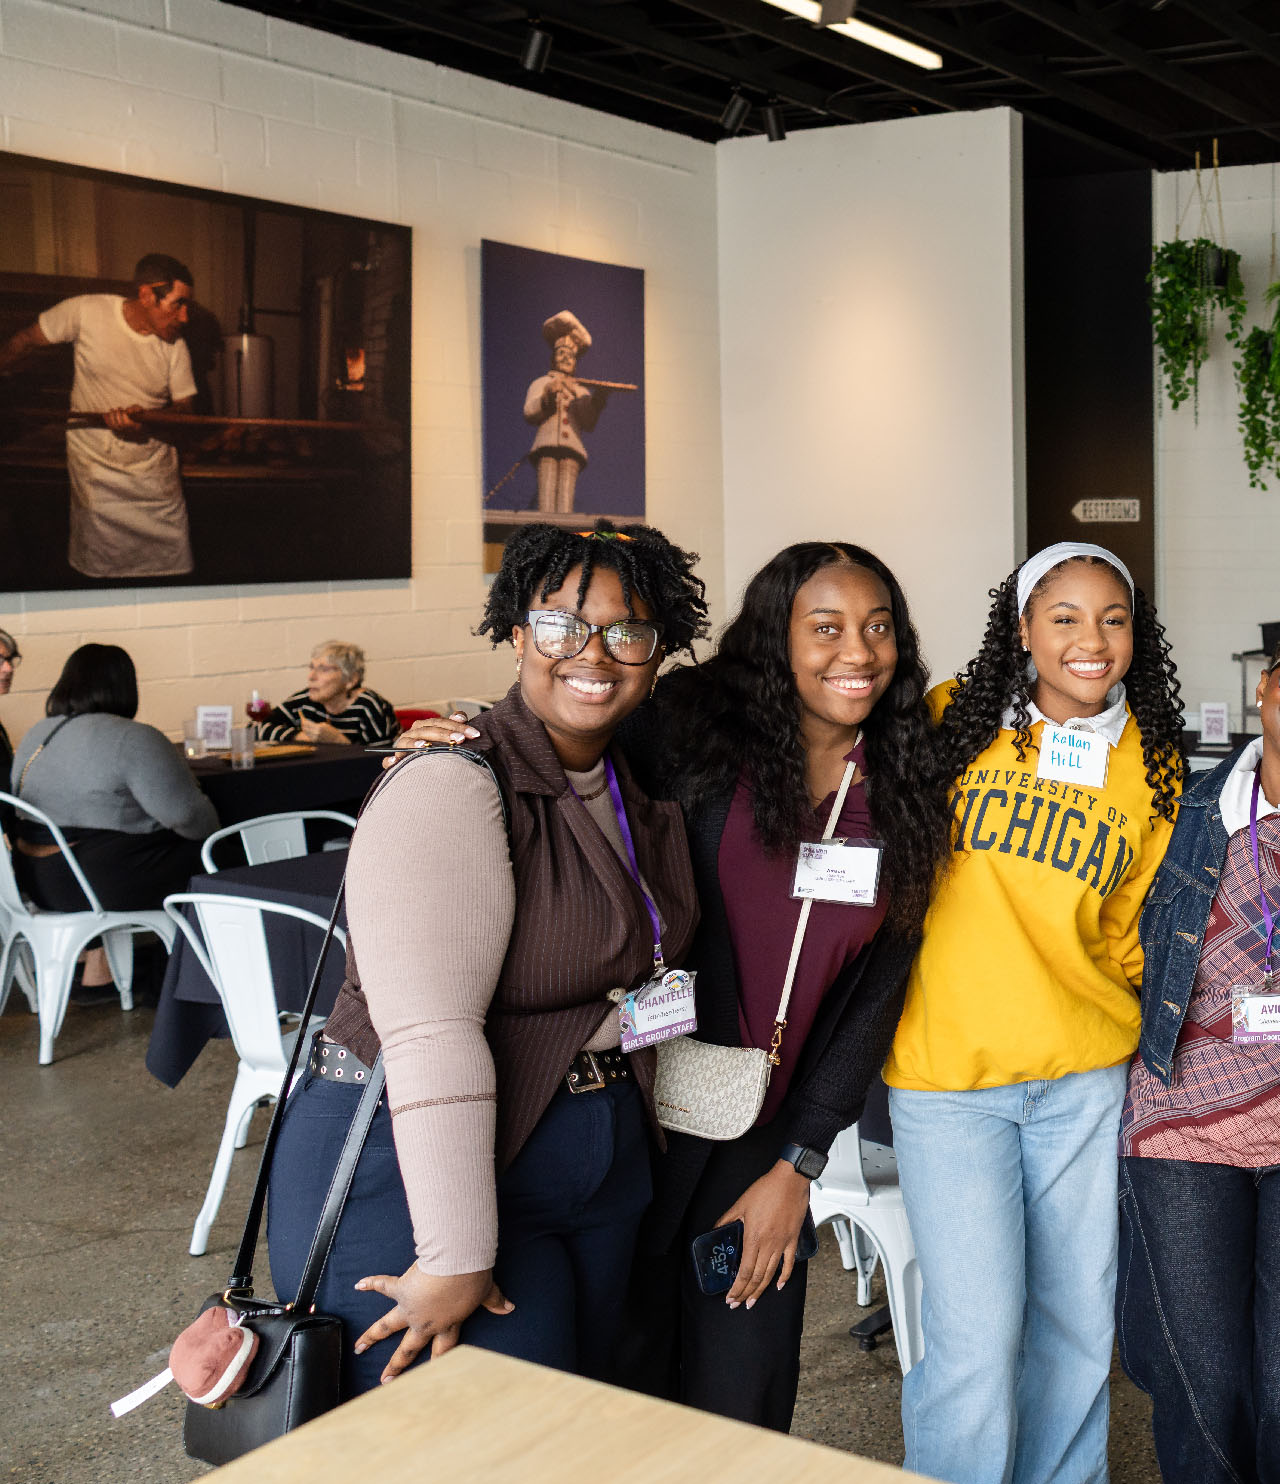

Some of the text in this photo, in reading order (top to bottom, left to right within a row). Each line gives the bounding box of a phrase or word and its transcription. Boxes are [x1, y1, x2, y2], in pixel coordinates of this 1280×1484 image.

[1082, 501, 1137, 519] RESTROOMS
[960, 769, 1128, 829] UNIVERSITY OF
[637, 986, 693, 1011] CHANTELLE
[622, 1021, 694, 1050] GIRLS GROUP STAFF
[1233, 1035, 1260, 1043] Program
[713, 1242, 729, 1275] 4:52
